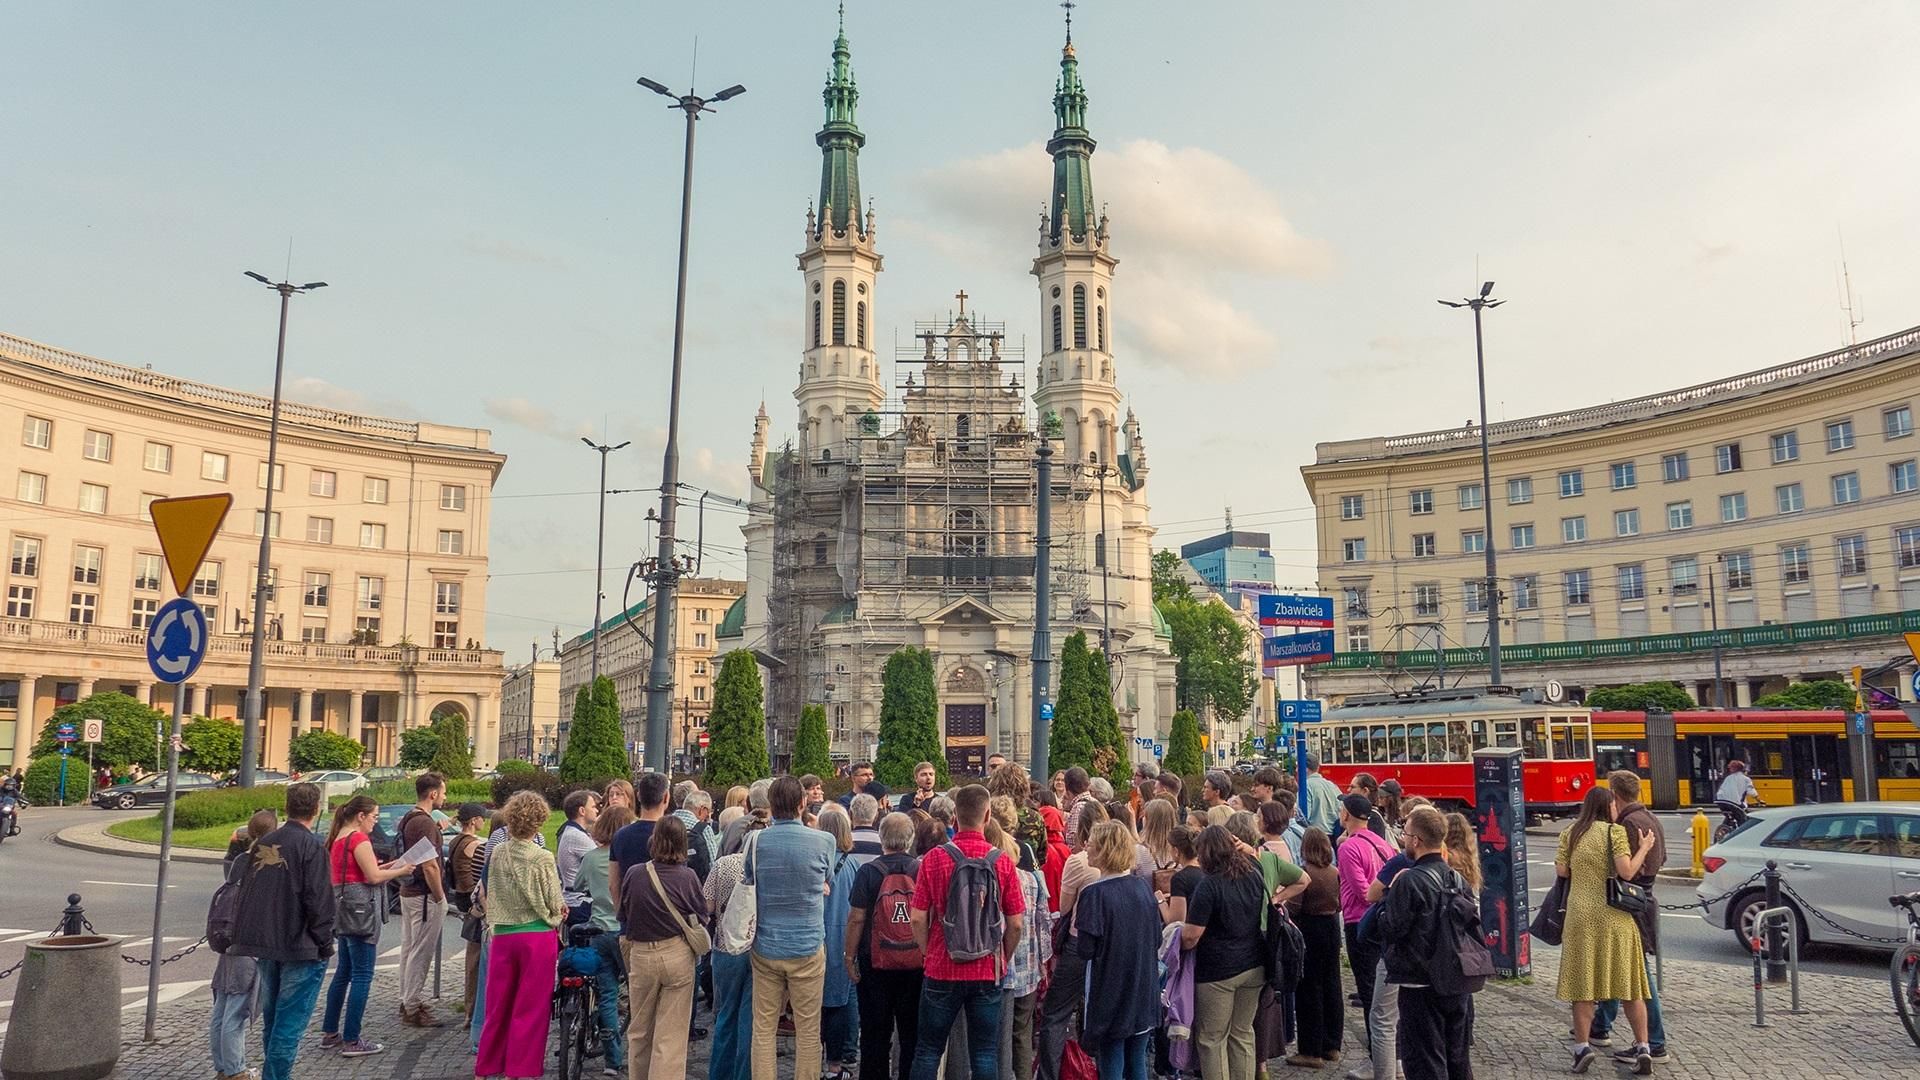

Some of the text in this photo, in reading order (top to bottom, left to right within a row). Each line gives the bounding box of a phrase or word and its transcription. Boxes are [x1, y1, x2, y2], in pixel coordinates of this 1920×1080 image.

[1275, 602, 1323, 616] Zbawiciela
[1551, 683, 1560, 697] D
[1286, 706, 1294, 716] P
[892, 902, 910, 923] A
